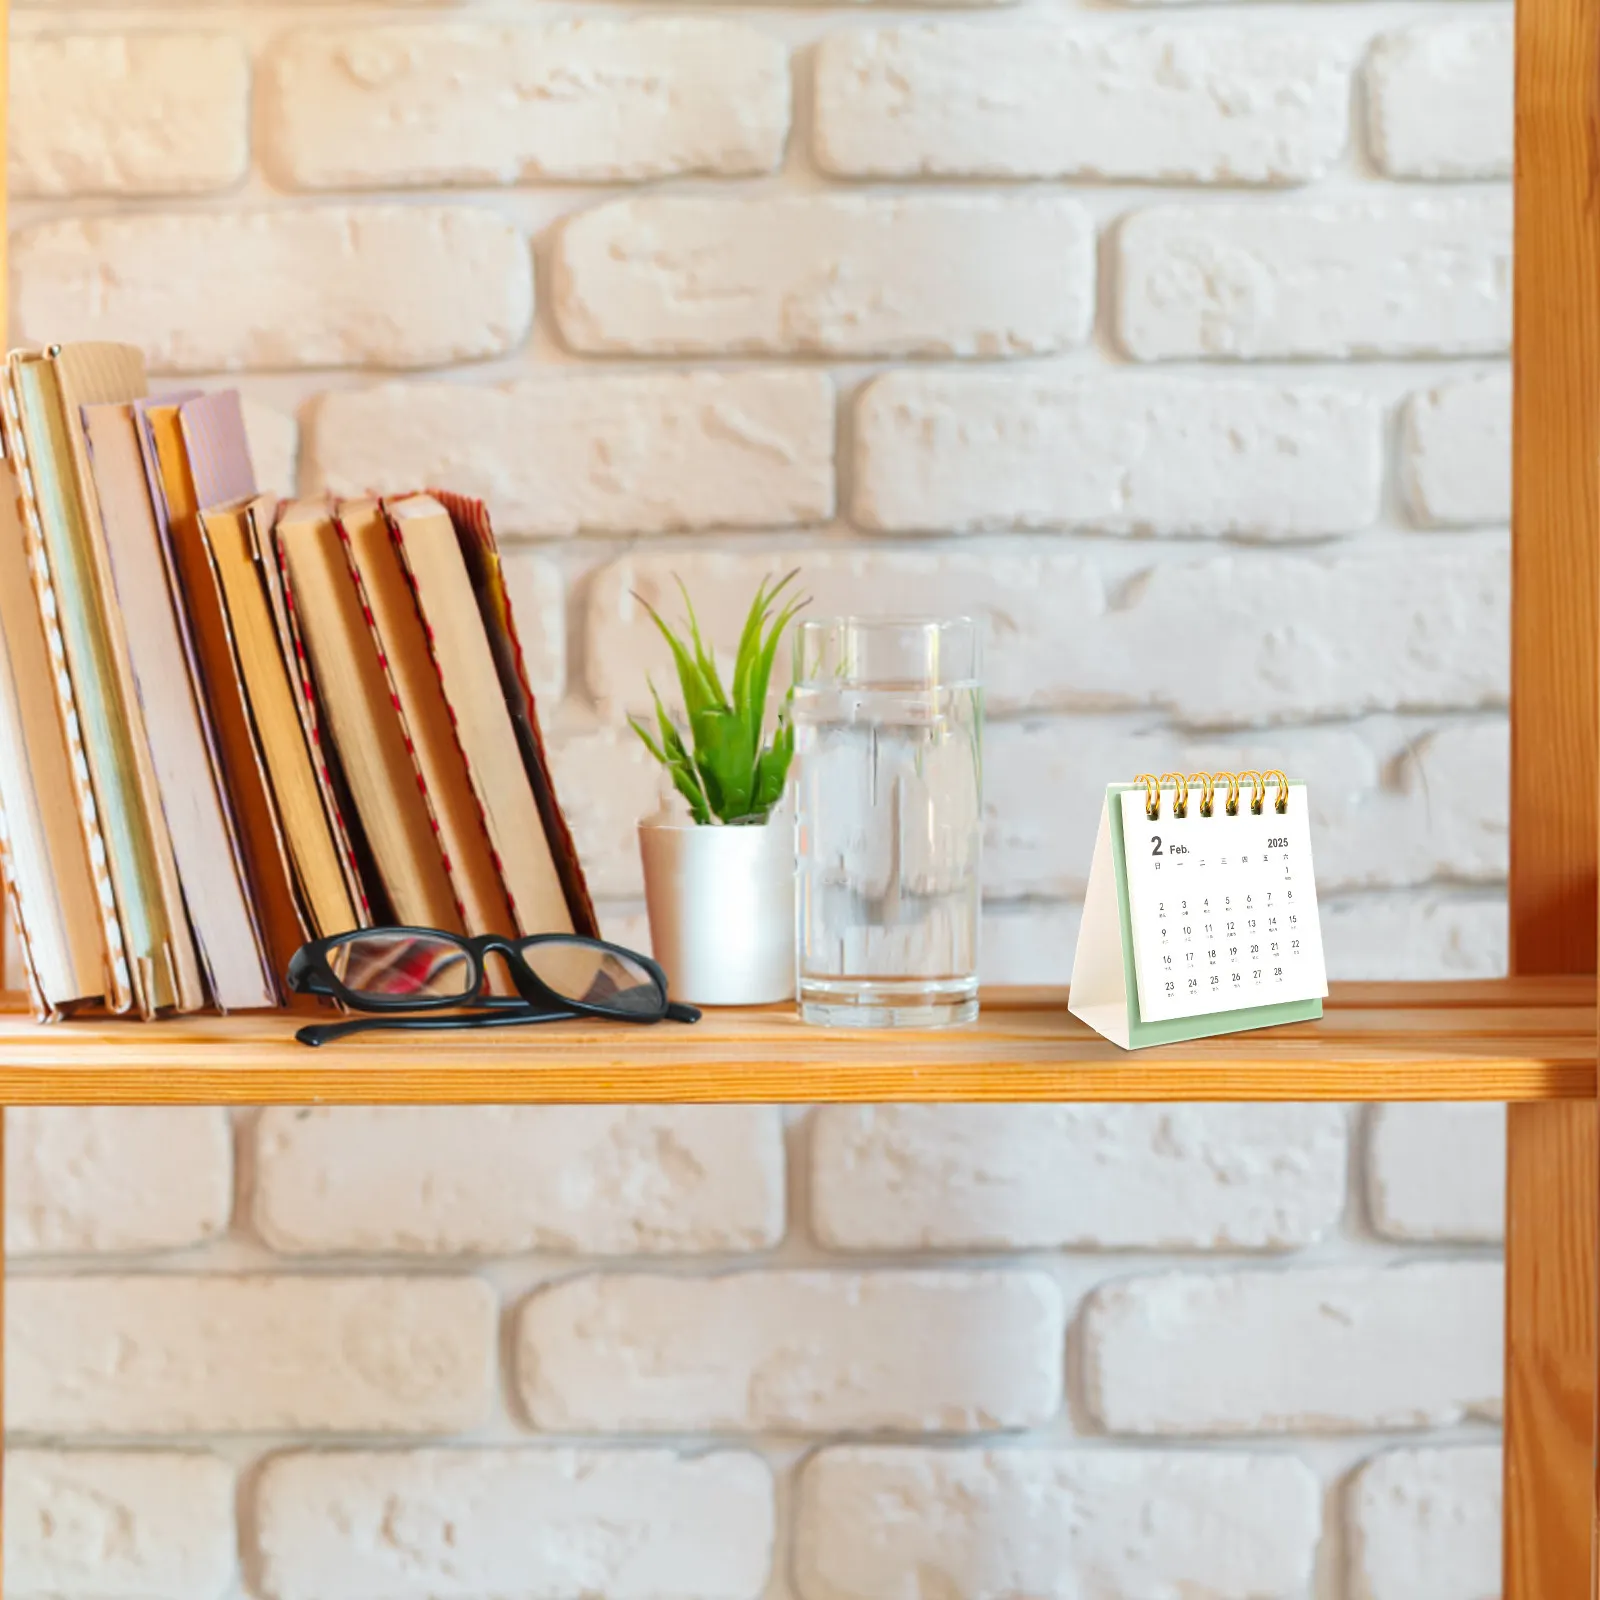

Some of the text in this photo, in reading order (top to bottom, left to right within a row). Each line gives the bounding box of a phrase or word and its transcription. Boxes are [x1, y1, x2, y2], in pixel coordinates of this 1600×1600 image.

[1151, 836, 1190, 856] 2 Feb.
[1268, 838, 1288, 848] 2025
[1159, 891, 1293, 911] 2 3 4 5 6 7 8
[1161, 929, 1167, 937] 9
[1183, 927, 1191, 935] 10
[1205, 924, 1213, 932] 11
[1227, 922, 1235, 930] 12
[1268, 917, 1277, 925] 14
[1289, 915, 1297, 923] 15
[1163, 955, 1171, 963] 16
[1208, 950, 1216, 958] 18
[1230, 947, 1237, 955] 19
[1250, 945, 1259, 953] 20
[1270, 943, 1279, 951] 21
[1291, 940, 1300, 948] 22
[1165, 967, 1282, 990] 23 24 25 26 27 28
